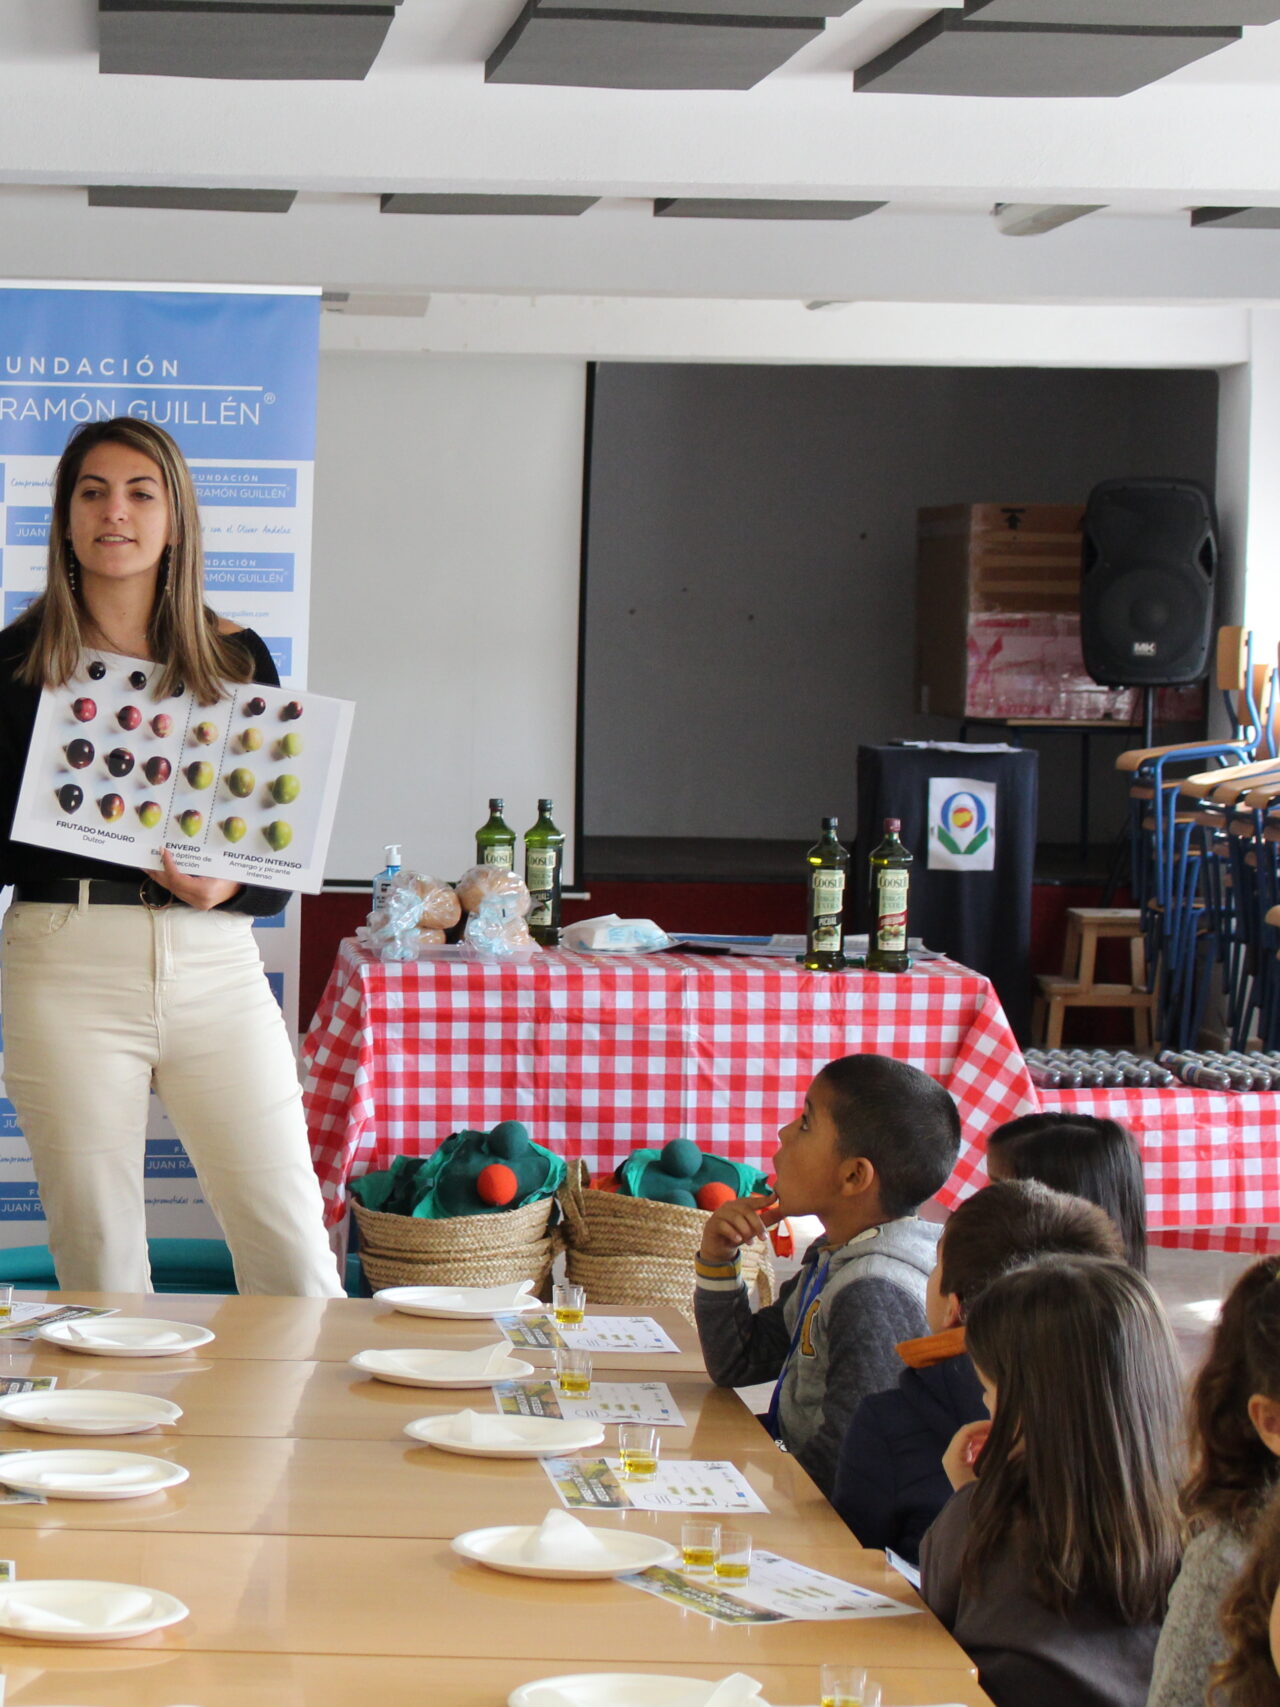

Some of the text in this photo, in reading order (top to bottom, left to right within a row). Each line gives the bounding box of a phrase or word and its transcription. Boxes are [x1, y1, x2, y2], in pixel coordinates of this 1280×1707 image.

[0, 393, 116, 422] RAMÓN
[127, 396, 260, 426] GUILLÉN
[192, 473, 259, 482] FUNDACIÓN
[196, 486, 286, 499] RAMÓN GUILLÉN
[16, 528, 46, 537] JUAN
[205, 559, 257, 567] NDACIÓN
[238, 573, 284, 583] GUILLÉN
[56, 820, 135, 843] FRUTADO MADURO
[82, 834, 106, 845] Dulzor
[165, 842, 201, 853] ENVERO
[175, 852, 202, 862] óptimo
[223, 850, 302, 870] FRUTADO INTENSO
[229, 860, 258, 871] Amargo
[263, 865, 291, 876] picante
[246, 870, 273, 880] intenso
[146, 1160, 176, 1170] JUAN
[1, 1203, 31, 1213] JUAN
